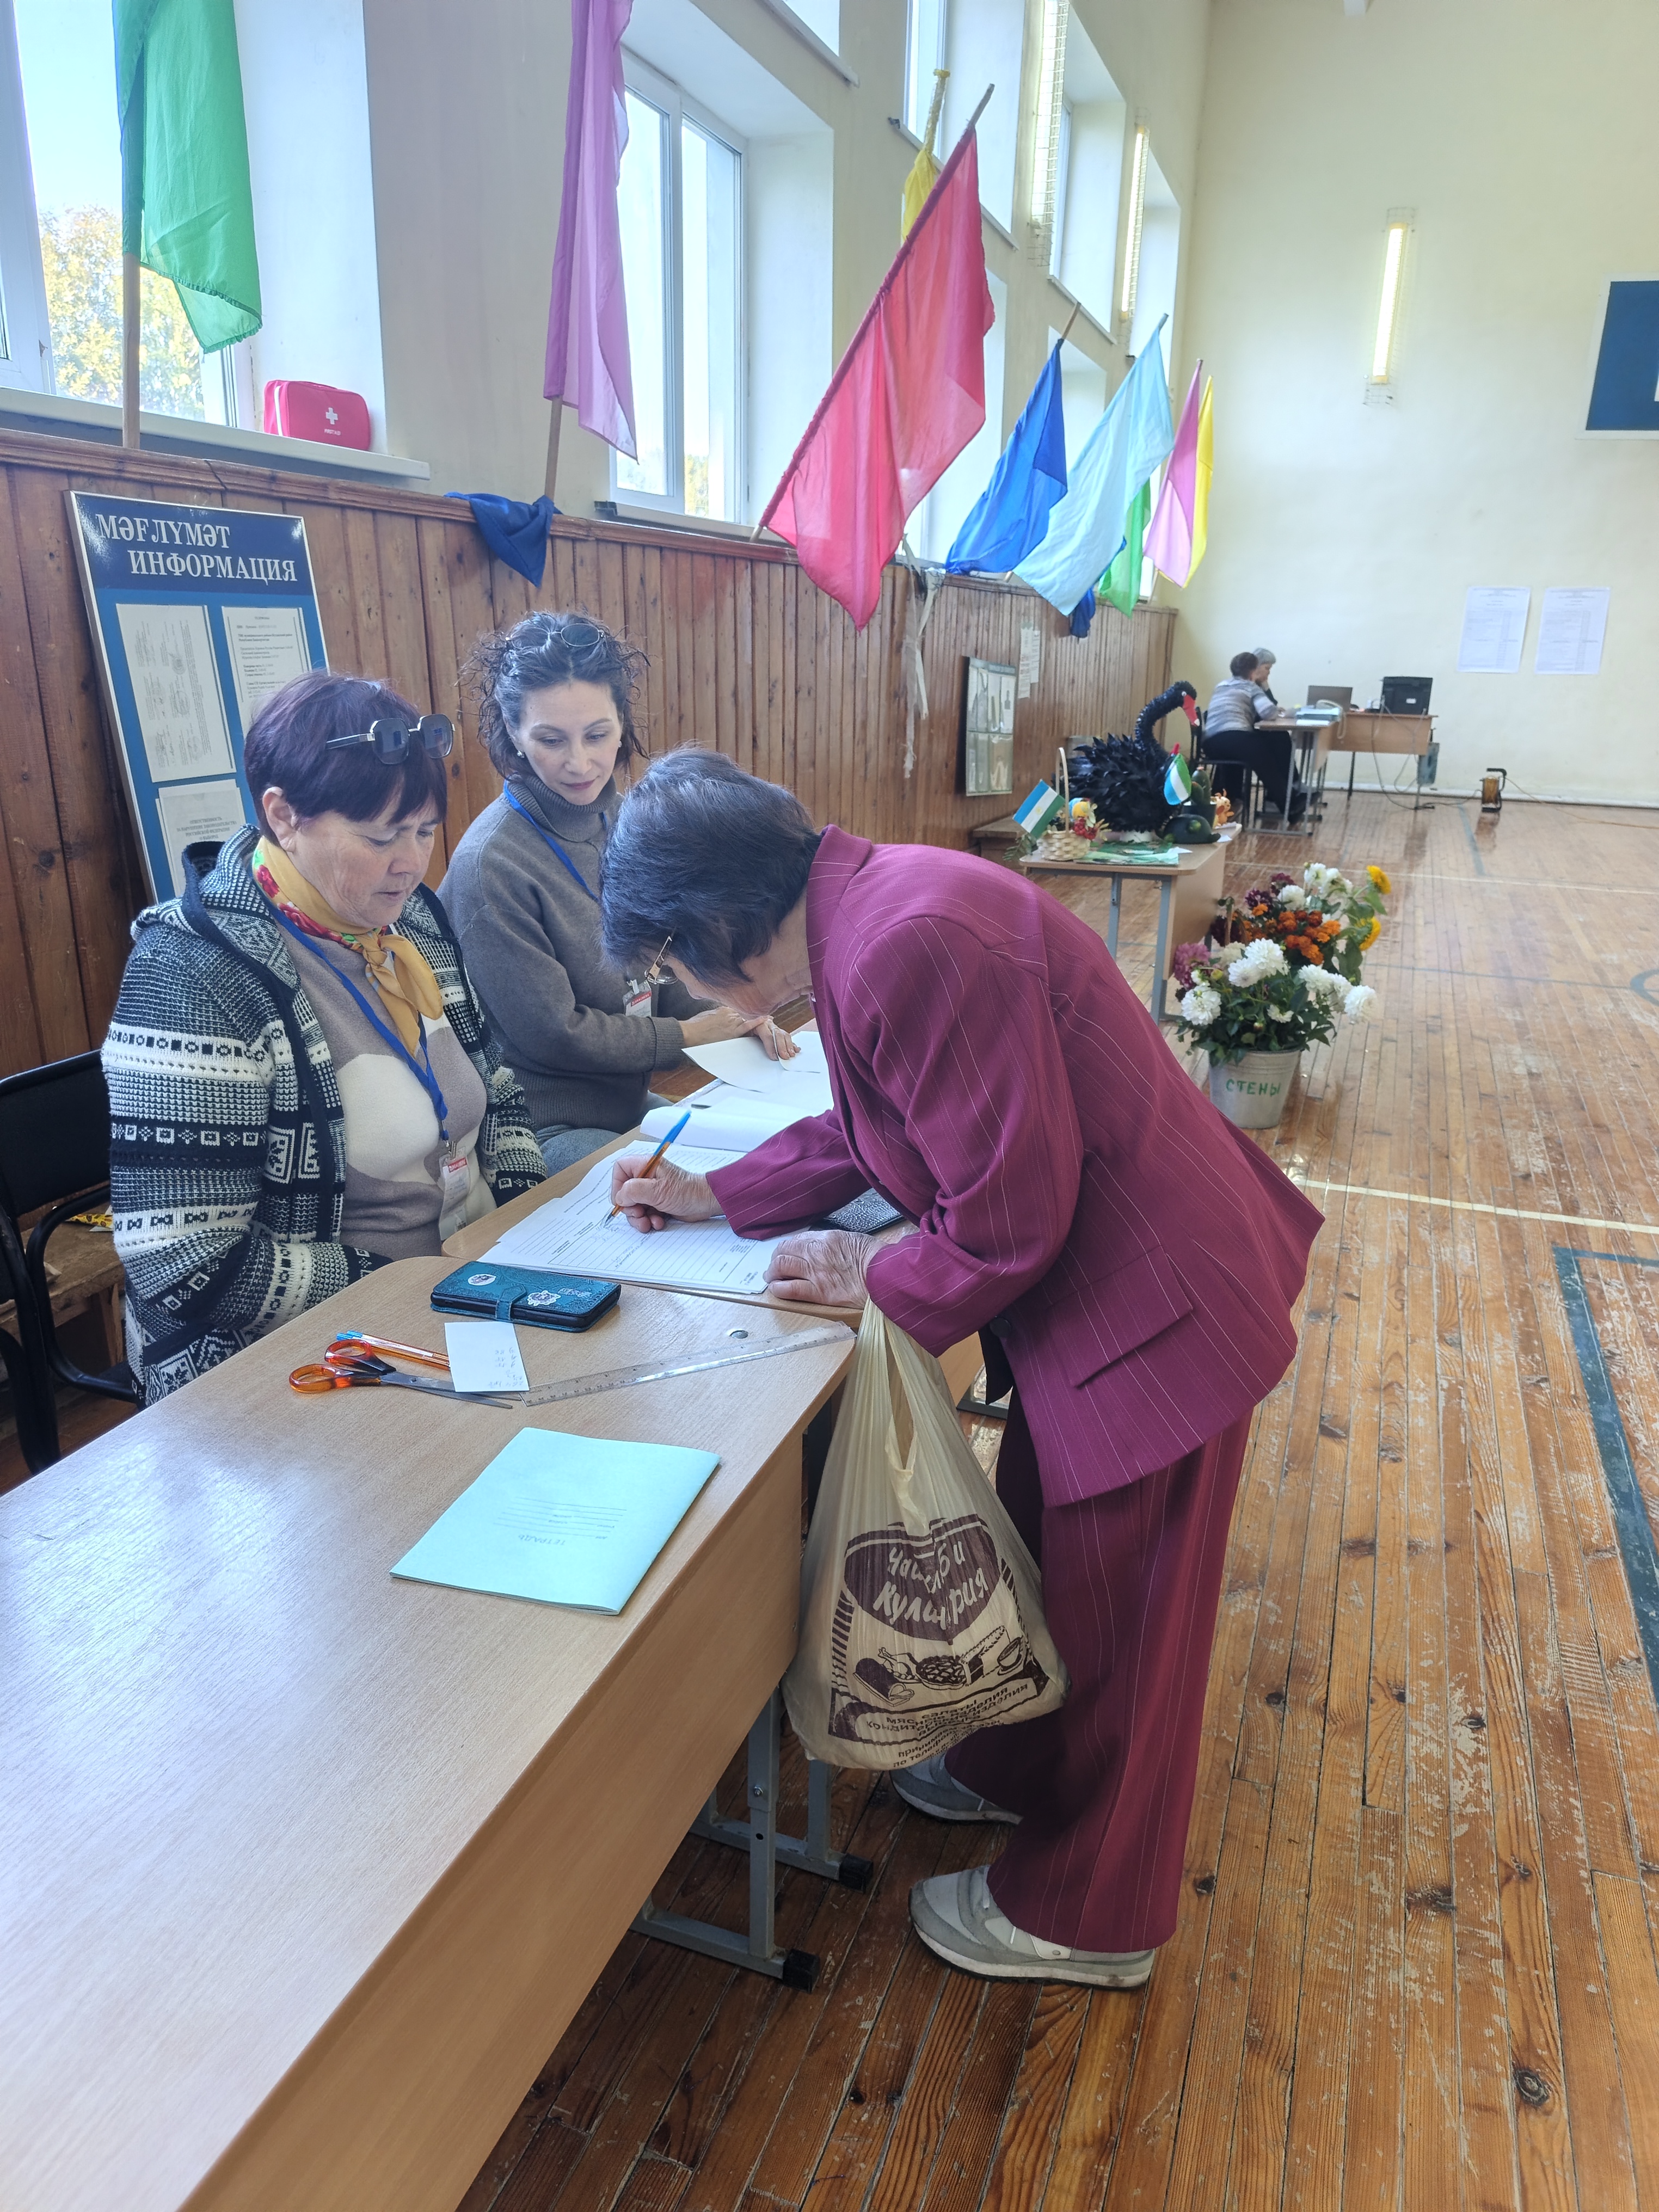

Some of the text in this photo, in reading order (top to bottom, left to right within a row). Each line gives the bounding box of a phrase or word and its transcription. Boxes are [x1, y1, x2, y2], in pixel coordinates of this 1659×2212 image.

[95, 513, 231, 549] МӘҒЛҮМӘТ
[127, 549, 298, 586] ИНФОРМАЦИЯ
[1226, 1078, 1282, 1097] СТЕНЫ
[518, 1534, 566, 1546] ТЕТРАДЬ
[872, 1567, 989, 1631] Кулинрия
[921, 1699, 977, 1719] салаты
